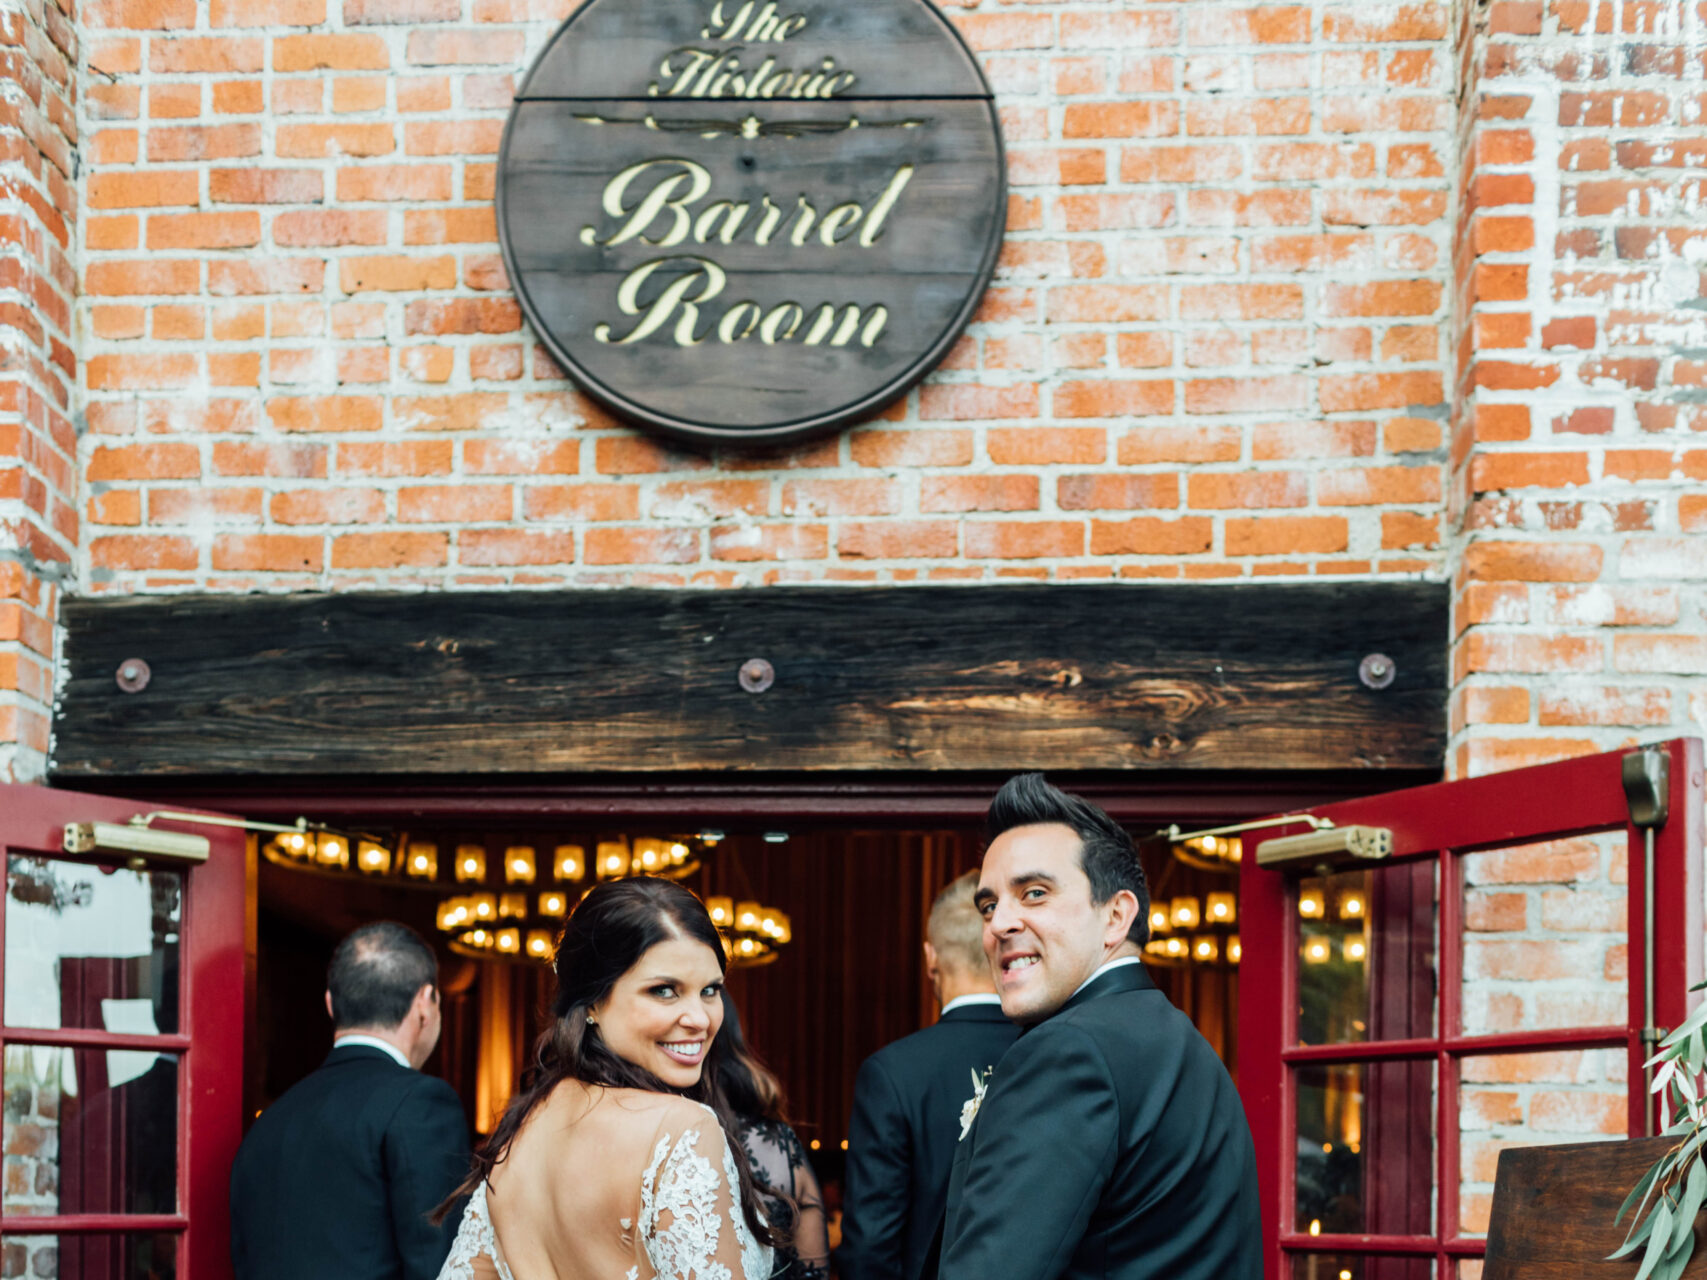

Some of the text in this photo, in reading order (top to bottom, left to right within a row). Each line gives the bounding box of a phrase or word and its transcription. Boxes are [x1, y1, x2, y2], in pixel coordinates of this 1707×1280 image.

[701, 0, 807, 42] The
[648, 46, 857, 98] Historic
[579, 156, 915, 248] Barrel
[594, 255, 889, 348] Room
